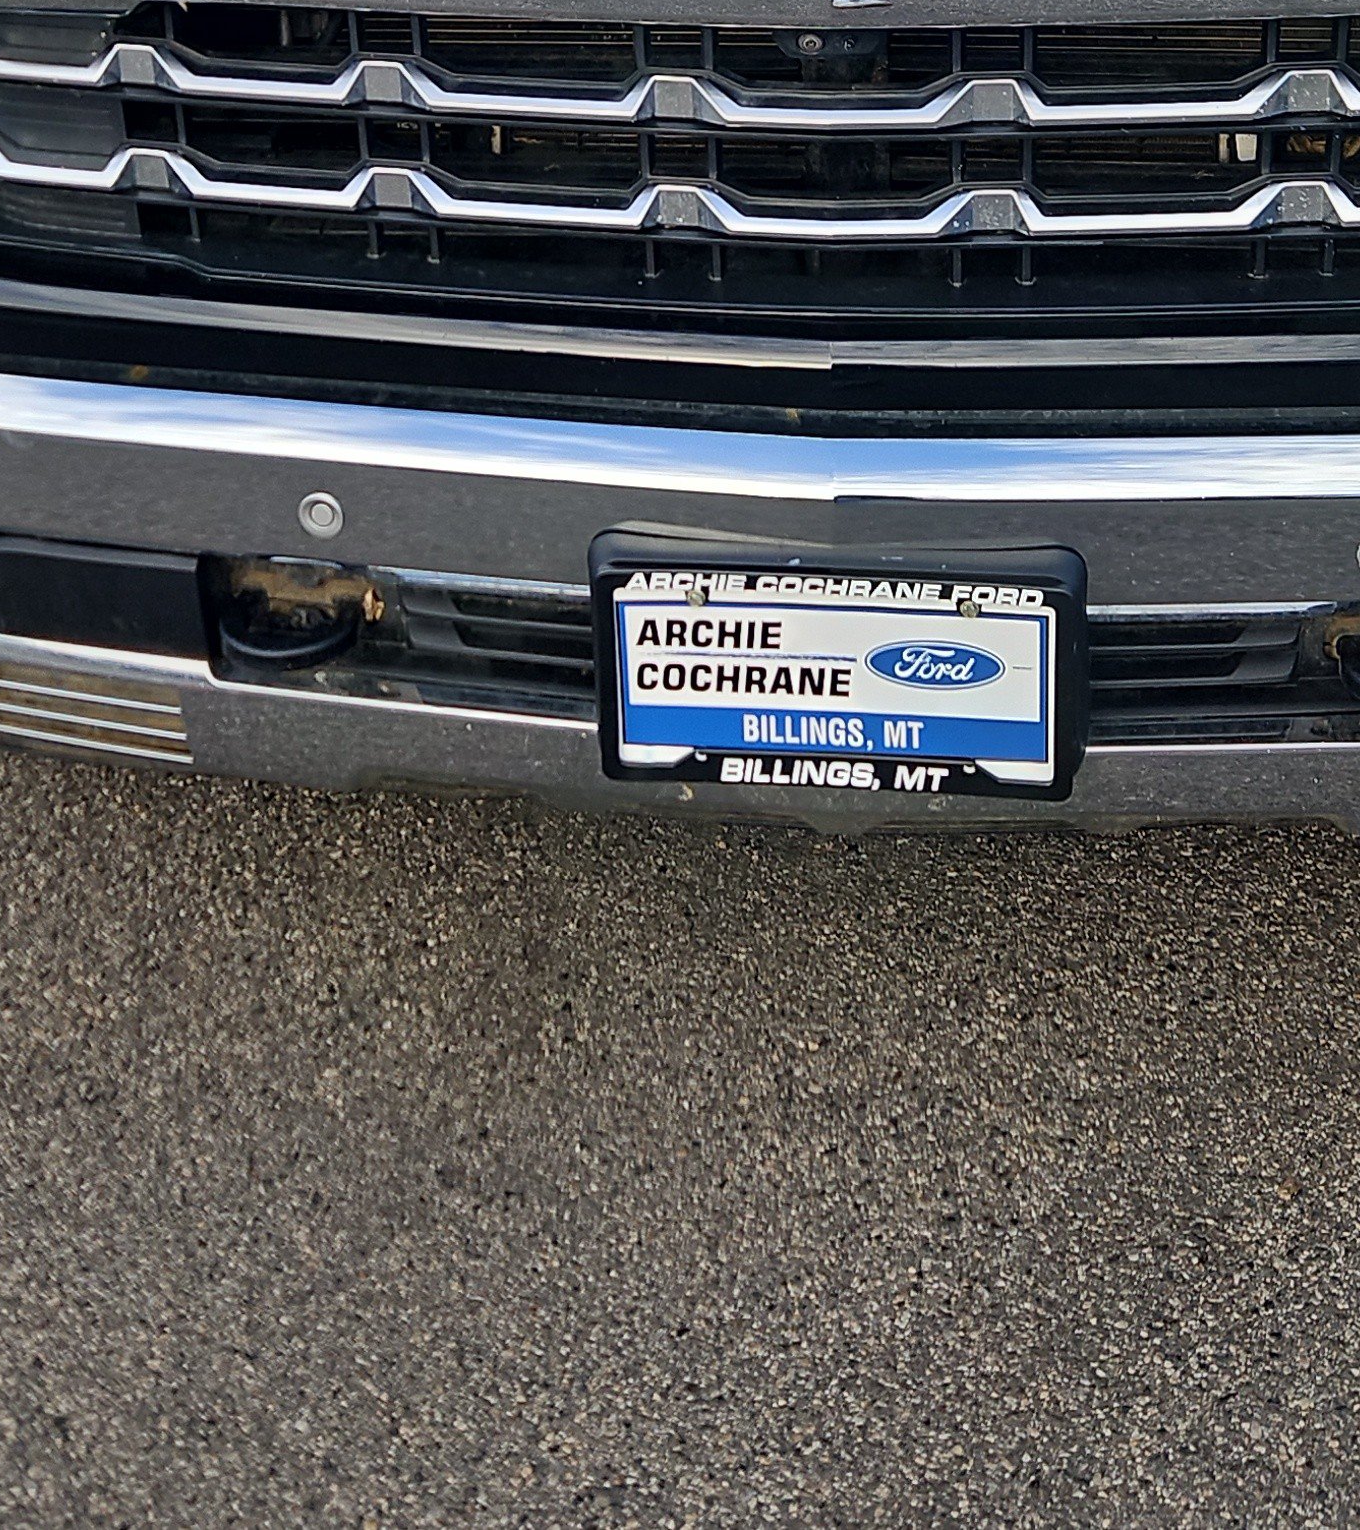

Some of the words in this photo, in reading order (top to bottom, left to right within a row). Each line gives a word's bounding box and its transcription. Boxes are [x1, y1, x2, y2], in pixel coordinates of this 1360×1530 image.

[624, 572, 747, 592] ARCHIE
[755, 575, 943, 601] COCHRANE
[951, 584, 1044, 607] FORD
[636, 619, 782, 649] ARCHIE
[636, 662, 852, 698] COCHRANE
[894, 647, 976, 682] Ford
[742, 714, 873, 751] BILLINGS,
[883, 720, 924, 750] MT
[720, 757, 881, 791] BILLINGS,
[894, 764, 950, 793] MT
